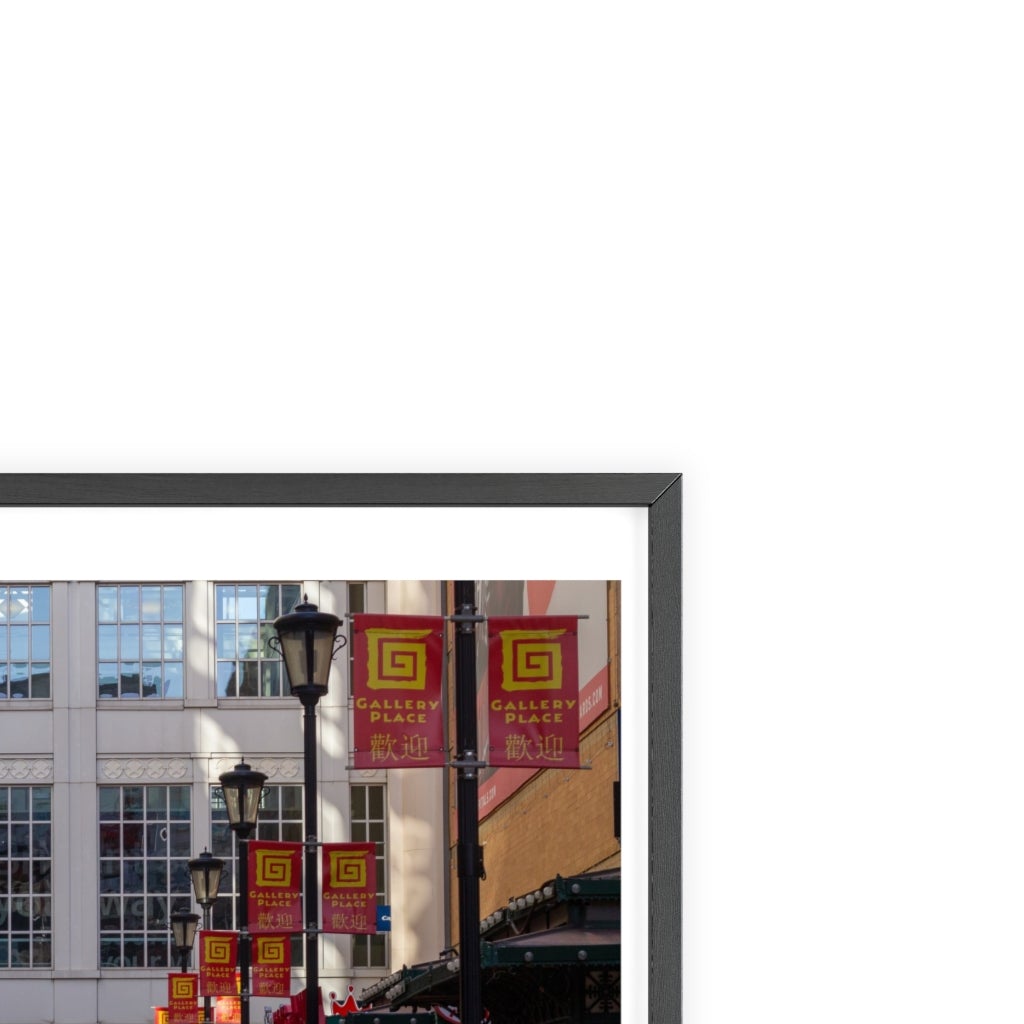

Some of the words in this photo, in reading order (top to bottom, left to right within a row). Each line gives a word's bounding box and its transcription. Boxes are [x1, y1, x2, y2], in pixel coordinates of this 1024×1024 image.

[355, 697, 440, 711] GALLERY
[490, 699, 577, 712] GALLERY
[370, 711, 427, 724] PLACE
[504, 712, 564, 725] PLACE
[370, 733, 430, 762] 歡迎
[503, 733, 565, 762] 歡迎
[249, 890, 300, 900] GALLERY
[323, 892, 375, 901] GALLERY
[257, 899, 293, 908] PLACE
[331, 901, 368, 909] PLACE
